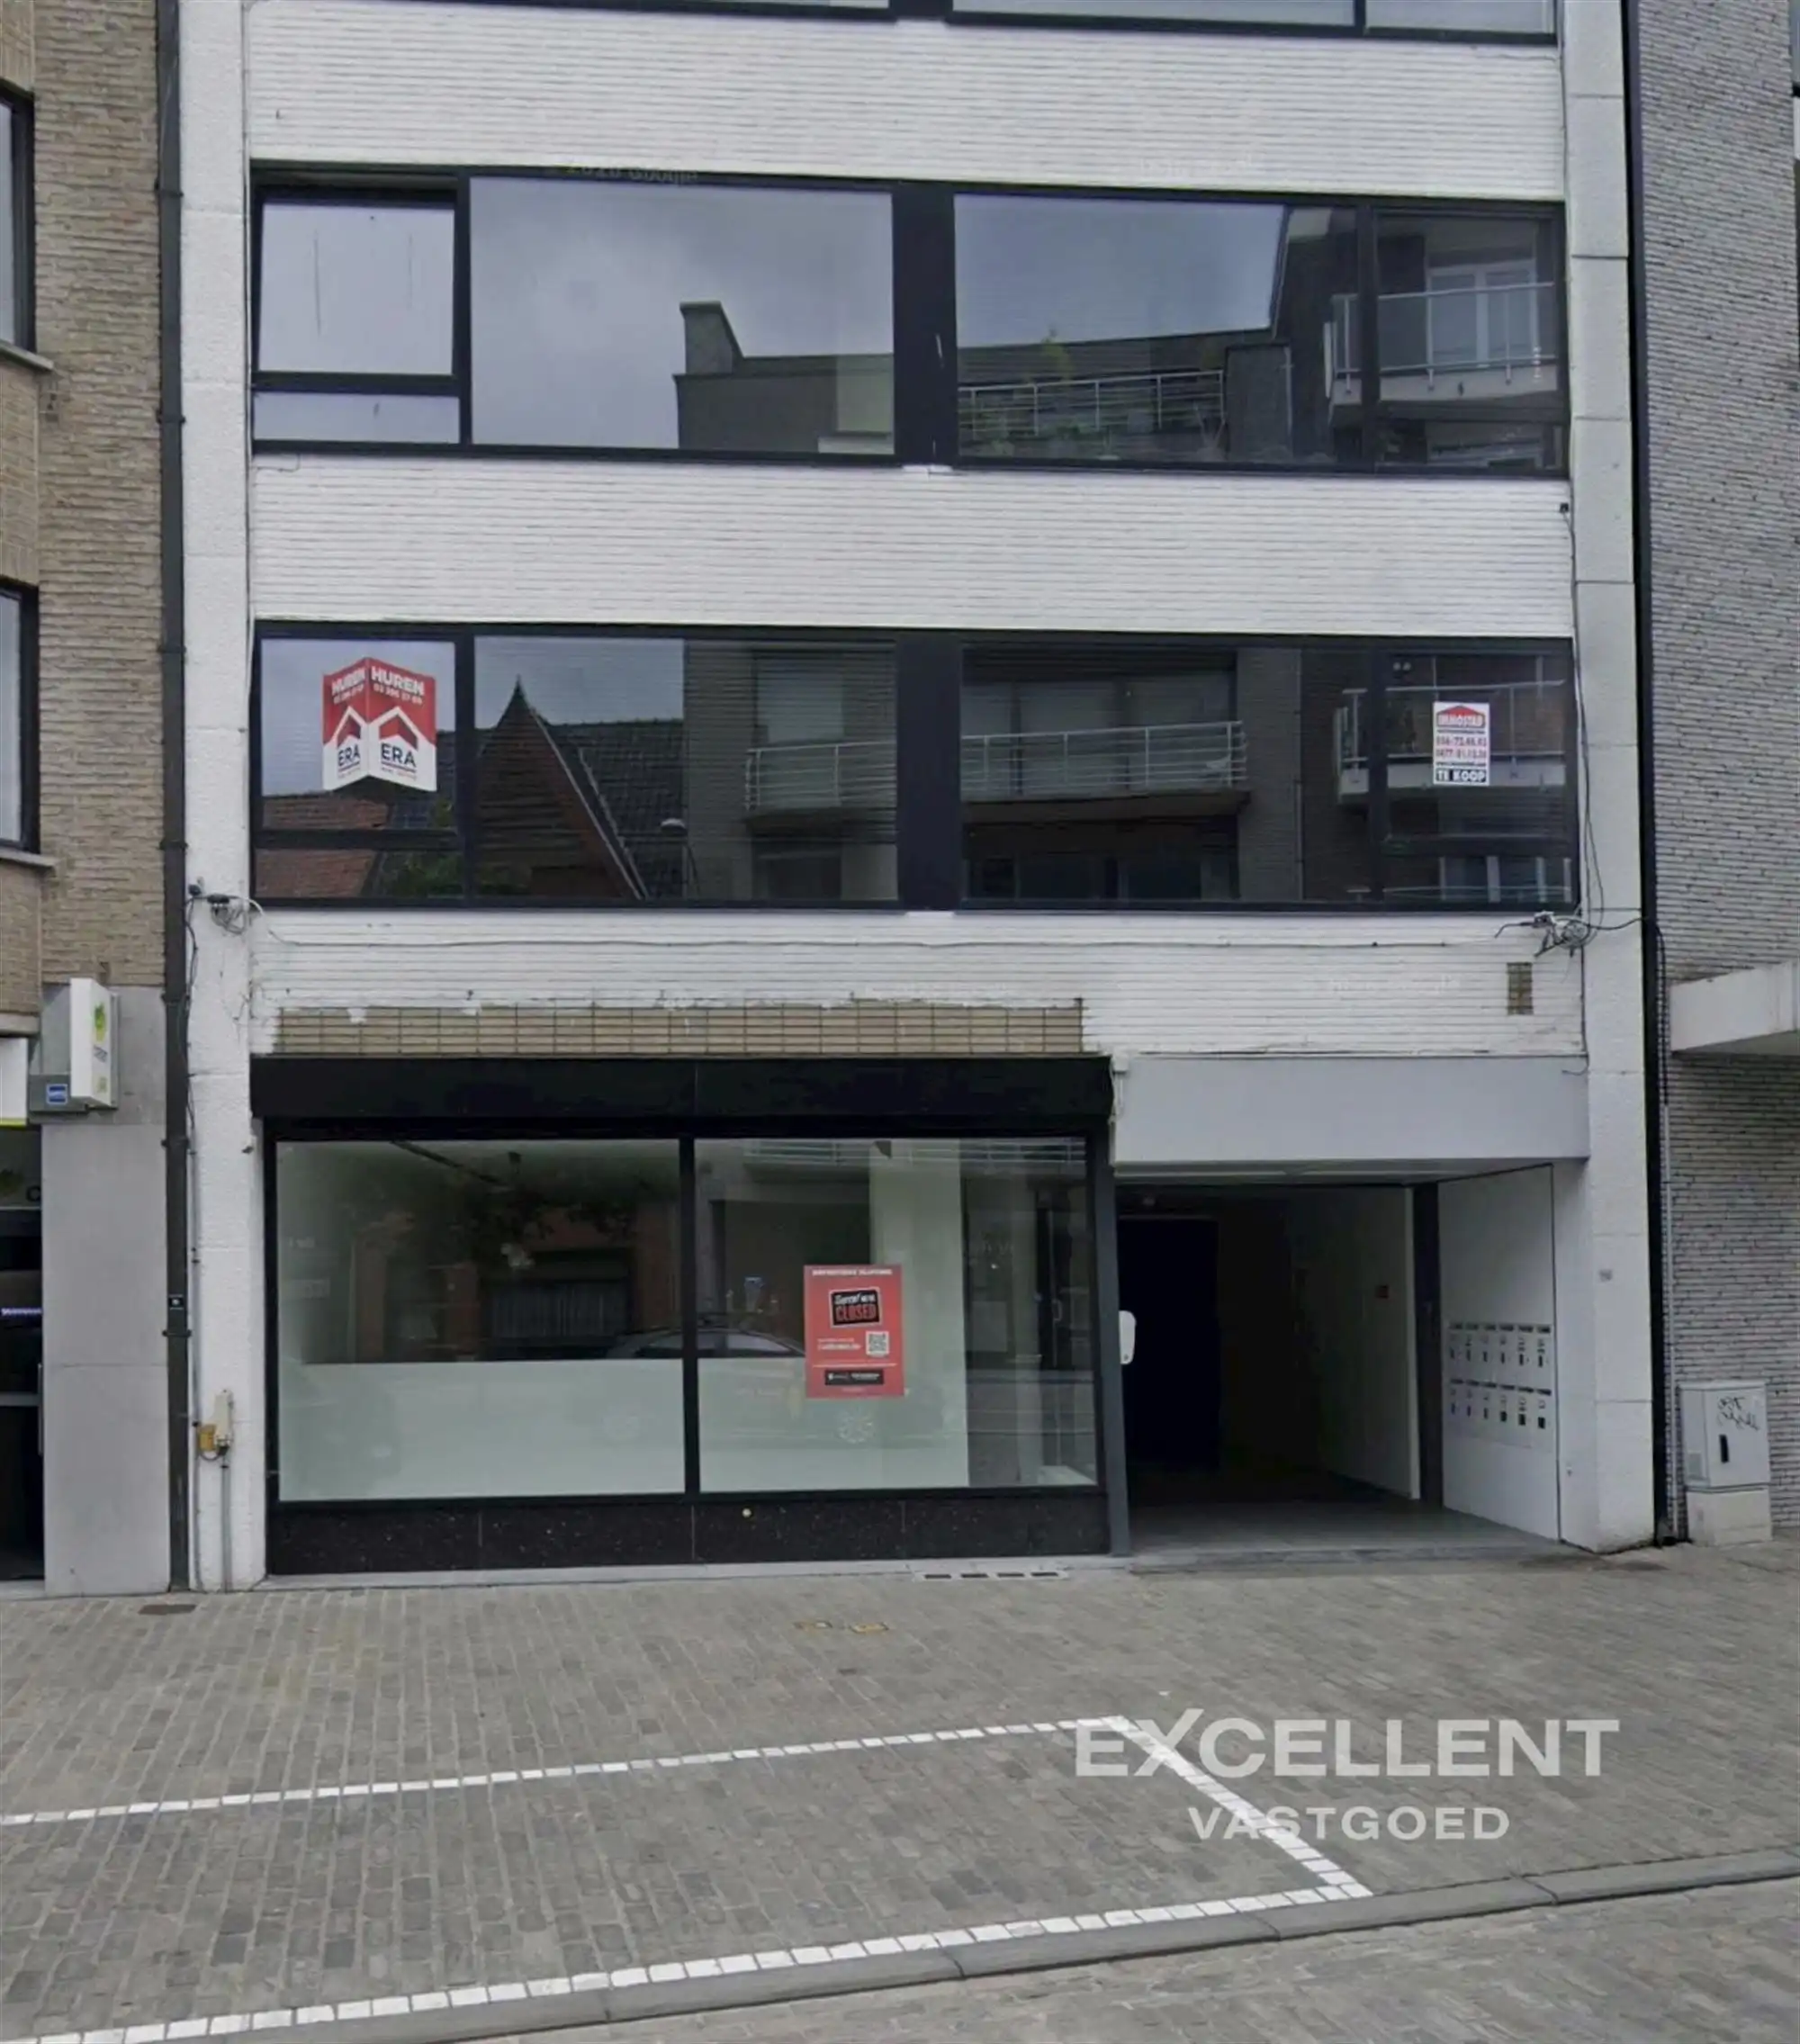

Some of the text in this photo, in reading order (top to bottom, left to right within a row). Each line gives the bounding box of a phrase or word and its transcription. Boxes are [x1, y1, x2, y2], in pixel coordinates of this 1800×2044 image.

[371, 666, 425, 697] HUREN
[338, 744, 360, 767] ERA
[381, 743, 416, 768] ERA
[835, 1303, 878, 1322] CLOSED
